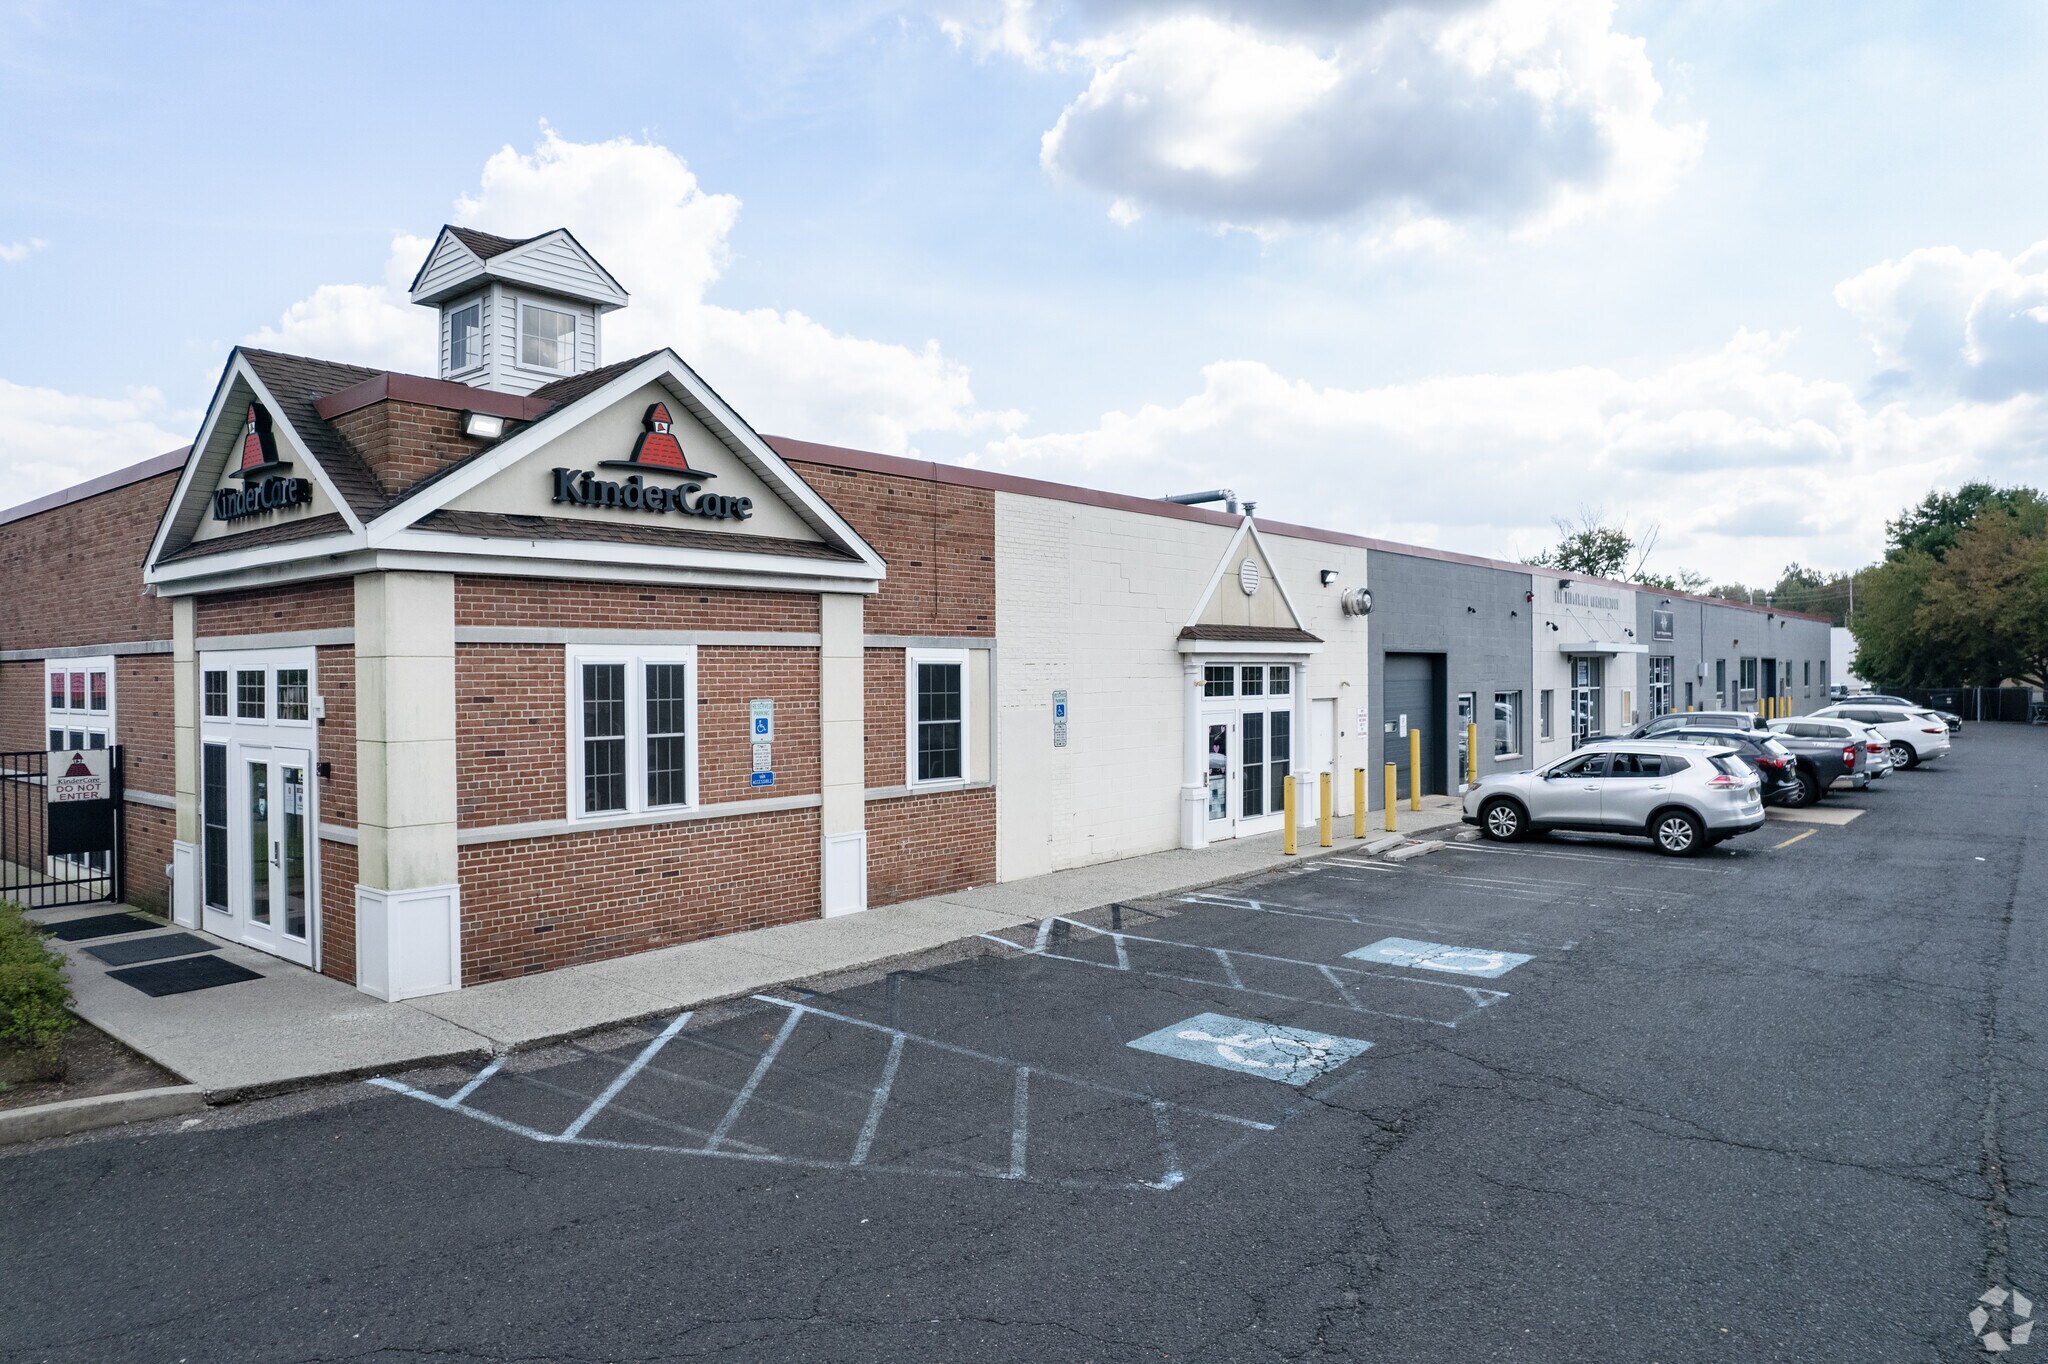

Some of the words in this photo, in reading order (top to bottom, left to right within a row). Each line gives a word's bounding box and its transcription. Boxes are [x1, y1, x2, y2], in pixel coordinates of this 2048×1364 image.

[213, 475, 306, 521] KinderCare
[552, 467, 753, 521] KinderCare
[57, 777, 100, 785] KinderCare
[56, 785, 73, 793] DO
[60, 792, 98, 800] ENTER
